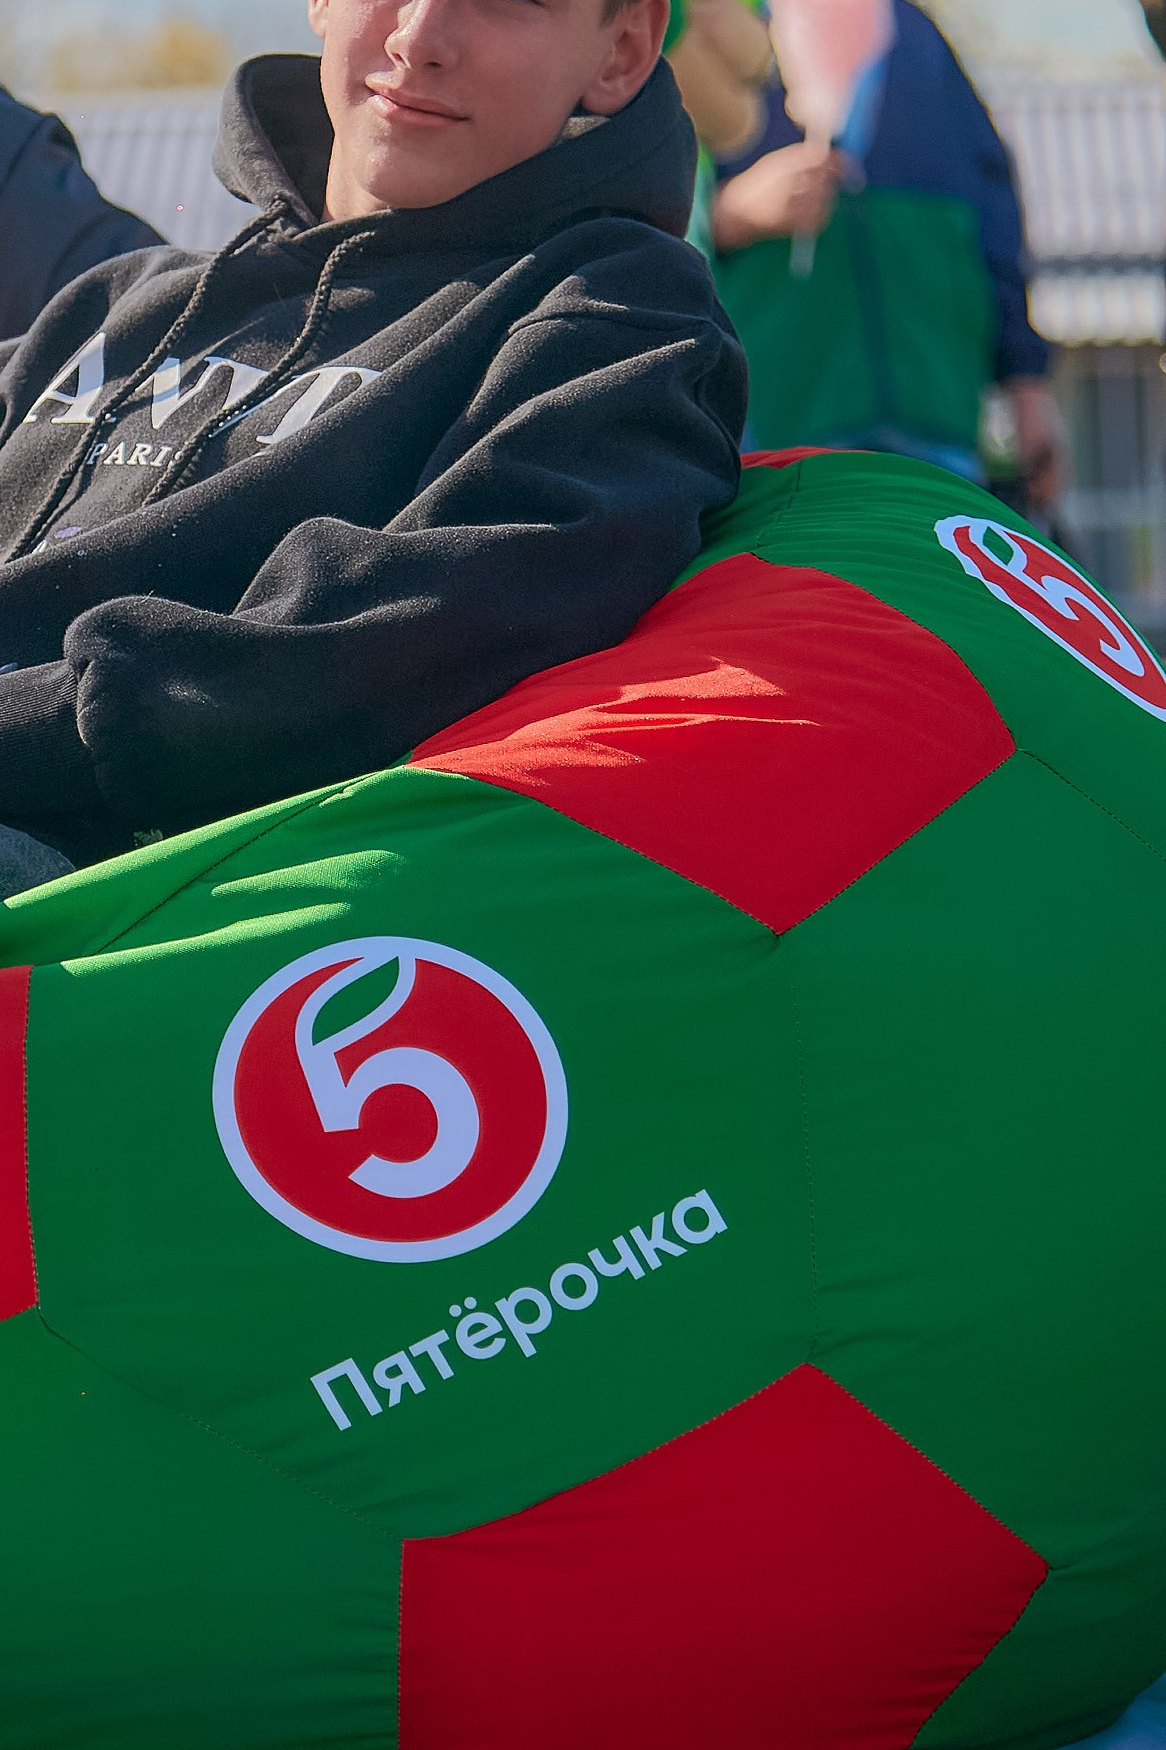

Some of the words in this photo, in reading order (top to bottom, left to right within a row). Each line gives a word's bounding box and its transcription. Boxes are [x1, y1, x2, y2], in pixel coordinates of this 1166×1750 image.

[968, 522, 1145, 678] 5
[295, 953, 480, 1199] 5
[310, 1188, 728, 1431] Пятёрочка
